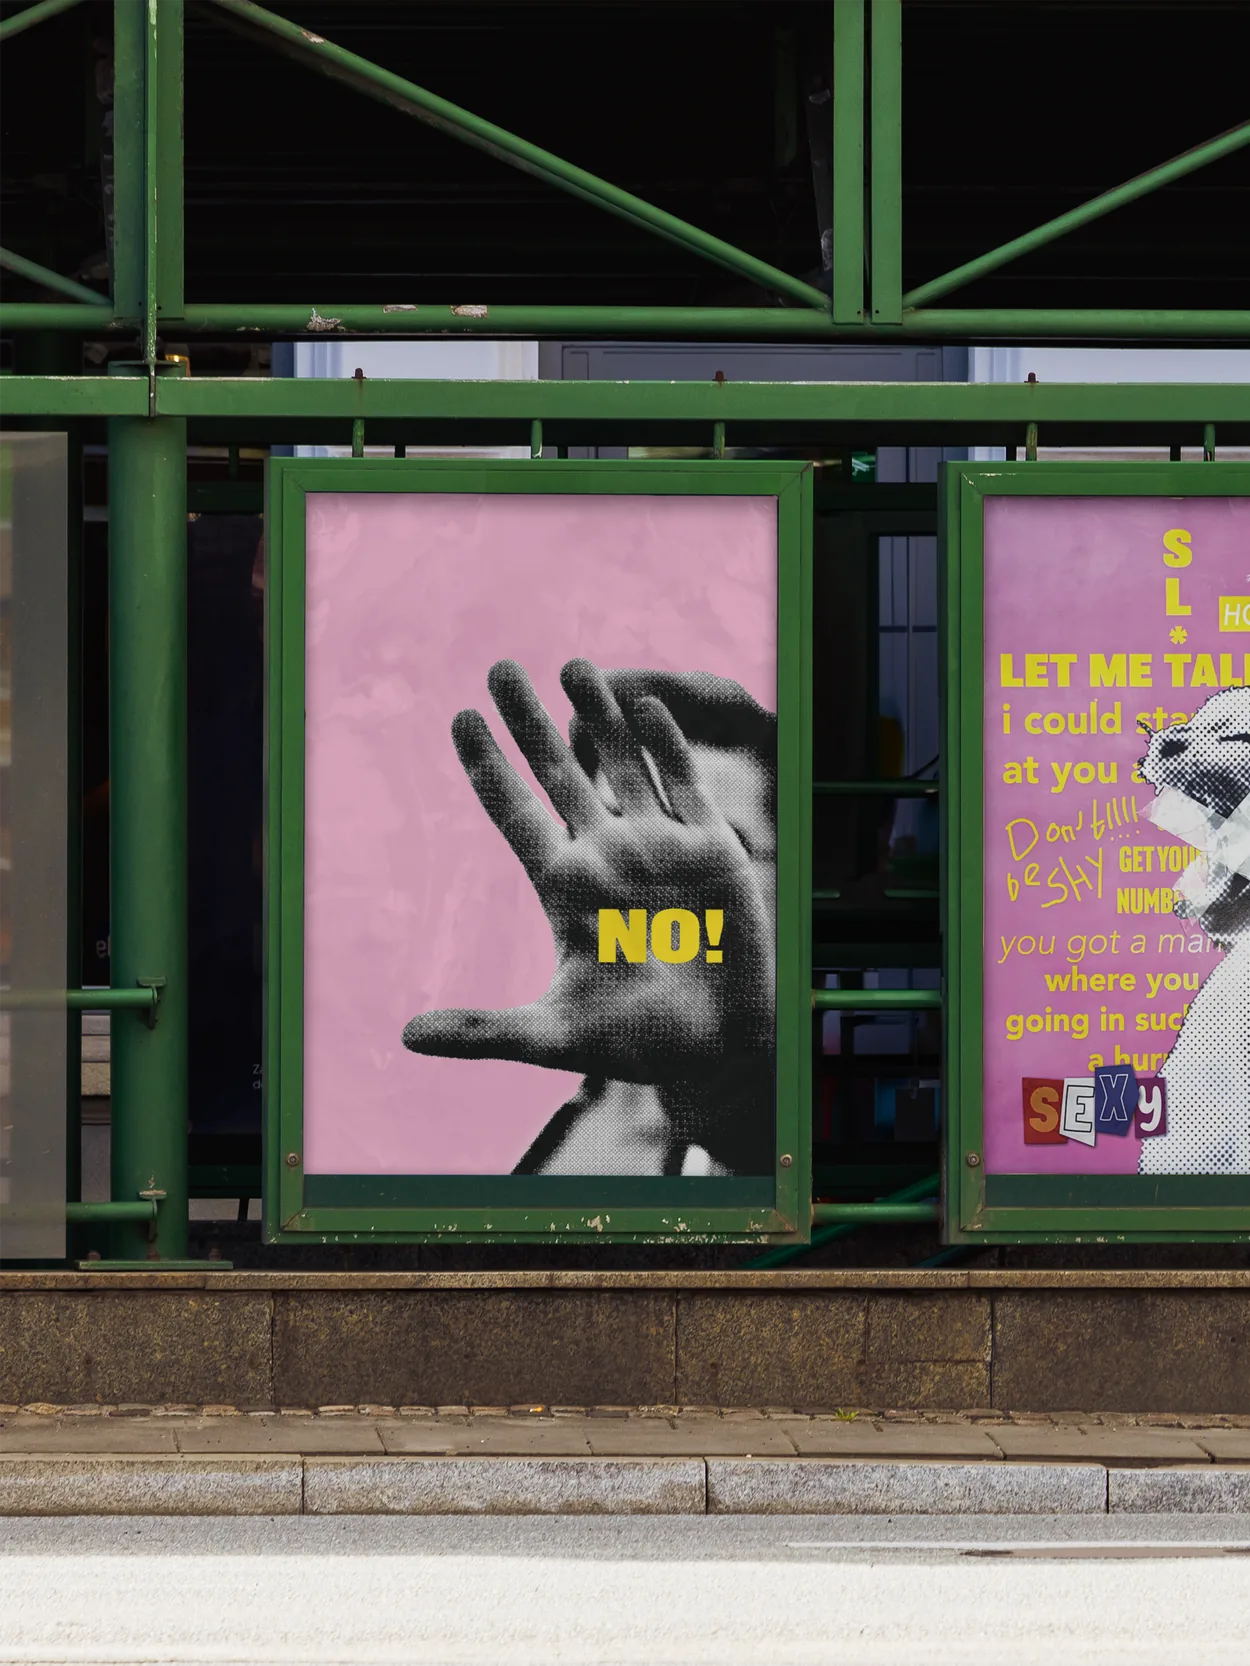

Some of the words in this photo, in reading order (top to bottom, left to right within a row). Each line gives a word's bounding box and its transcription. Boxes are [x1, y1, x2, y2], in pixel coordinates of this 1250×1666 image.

[1000, 654, 1078, 687] LET
[1090, 654, 1152, 687] ME
[1003, 704, 1010, 734] i
[1024, 702, 1121, 734] could
[1003, 756, 1039, 784] at
[1051, 762, 1117, 793] you
[1120, 846, 1154, 872] GET
[1007, 862, 1041, 902] be
[1042, 848, 1103, 909] SHY
[598, 908, 723, 964] NO!
[999, 936, 1055, 963] you
[1067, 931, 1120, 962] got
[1131, 934, 1146, 953] a
[1045, 965, 1136, 992] where
[1146, 973, 1198, 998] you
[1006, 1006, 1089, 1040] going
[1101, 1006, 1124, 1031] in
[1136, 1004, 1189, 1031] suc
